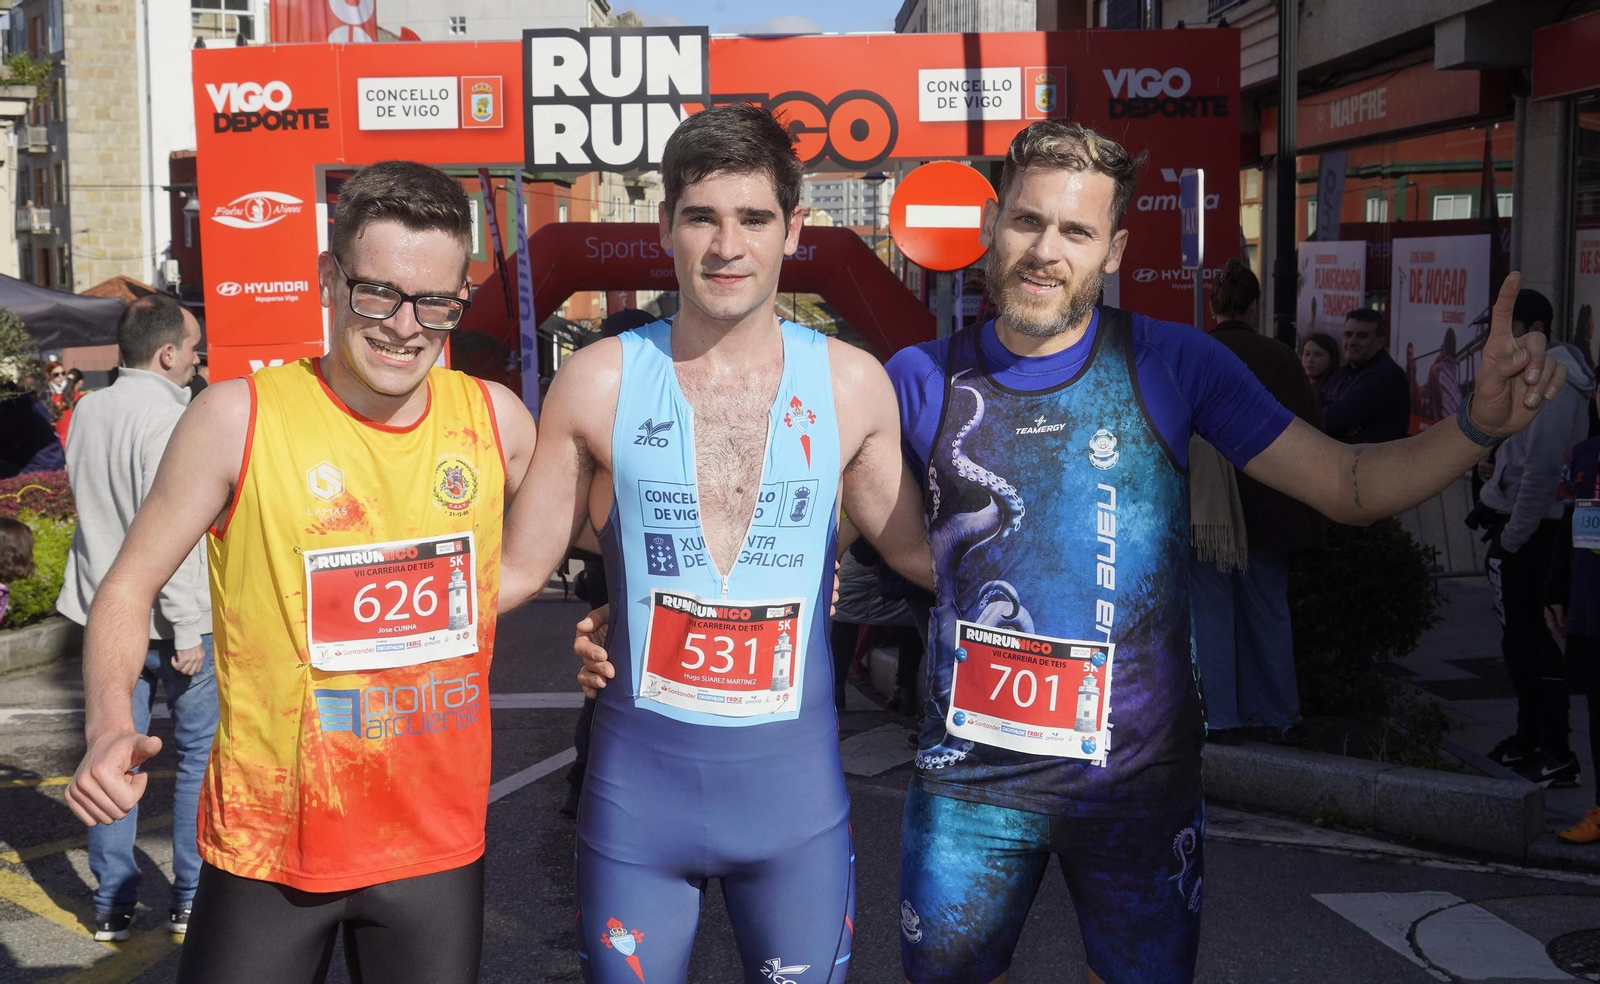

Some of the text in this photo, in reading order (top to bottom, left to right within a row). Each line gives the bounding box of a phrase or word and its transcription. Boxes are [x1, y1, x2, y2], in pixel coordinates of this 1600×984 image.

[531, 34, 702, 98] RUN
[926, 79, 1012, 94] CONCELLO
[1102, 67, 1191, 99] VIGO
[205, 80, 292, 113] VIGO
[365, 88, 449, 102] CONCELLO
[937, 95, 1002, 109] DE VIGO
[376, 104, 440, 118] DE VIGO
[1109, 95, 1229, 119] DEPORTE
[1329, 87, 1388, 129] MAPFRE
[213, 108, 330, 133] DEPORTE
[1182, 206, 1199, 235] TAXI
[586, 237, 660, 263] Sports
[244, 280, 309, 294] HYUNDAI
[1409, 268, 1467, 306] DE HOGAR
[255, 295, 299, 304] Hyupersa Vigo
[1015, 423, 1066, 435] TEAMERGY
[633, 434, 669, 448] ZICO
[306, 506, 349, 516] LAMAS
[654, 507, 672, 521] DE
[1097, 483, 1116, 590] BUEU
[449, 555, 464, 568] 5K
[683, 550, 804, 568] DE GALICIA
[354, 561, 435, 578] VII CARREIRA DE TEIS
[353, 575, 438, 623] 626
[393, 624, 417, 633] CUNHA
[698, 621, 736, 631] CARREIRA
[738, 624, 749, 632] DE
[750, 624, 764, 632] TEIS
[777, 620, 791, 631] 5K
[343, 647, 375, 656] Santander
[680, 633, 756, 675] 531
[992, 650, 1067, 669] VII CARREIRA DE TEIS
[684, 672, 757, 686] Hugo SUAREZ MARTINEZ
[667, 687, 696, 700] Santander
[989, 663, 1058, 712] 701
[364, 672, 480, 722] portas
[364, 702, 480, 741] arcuense
[974, 719, 1001, 732] Santander
